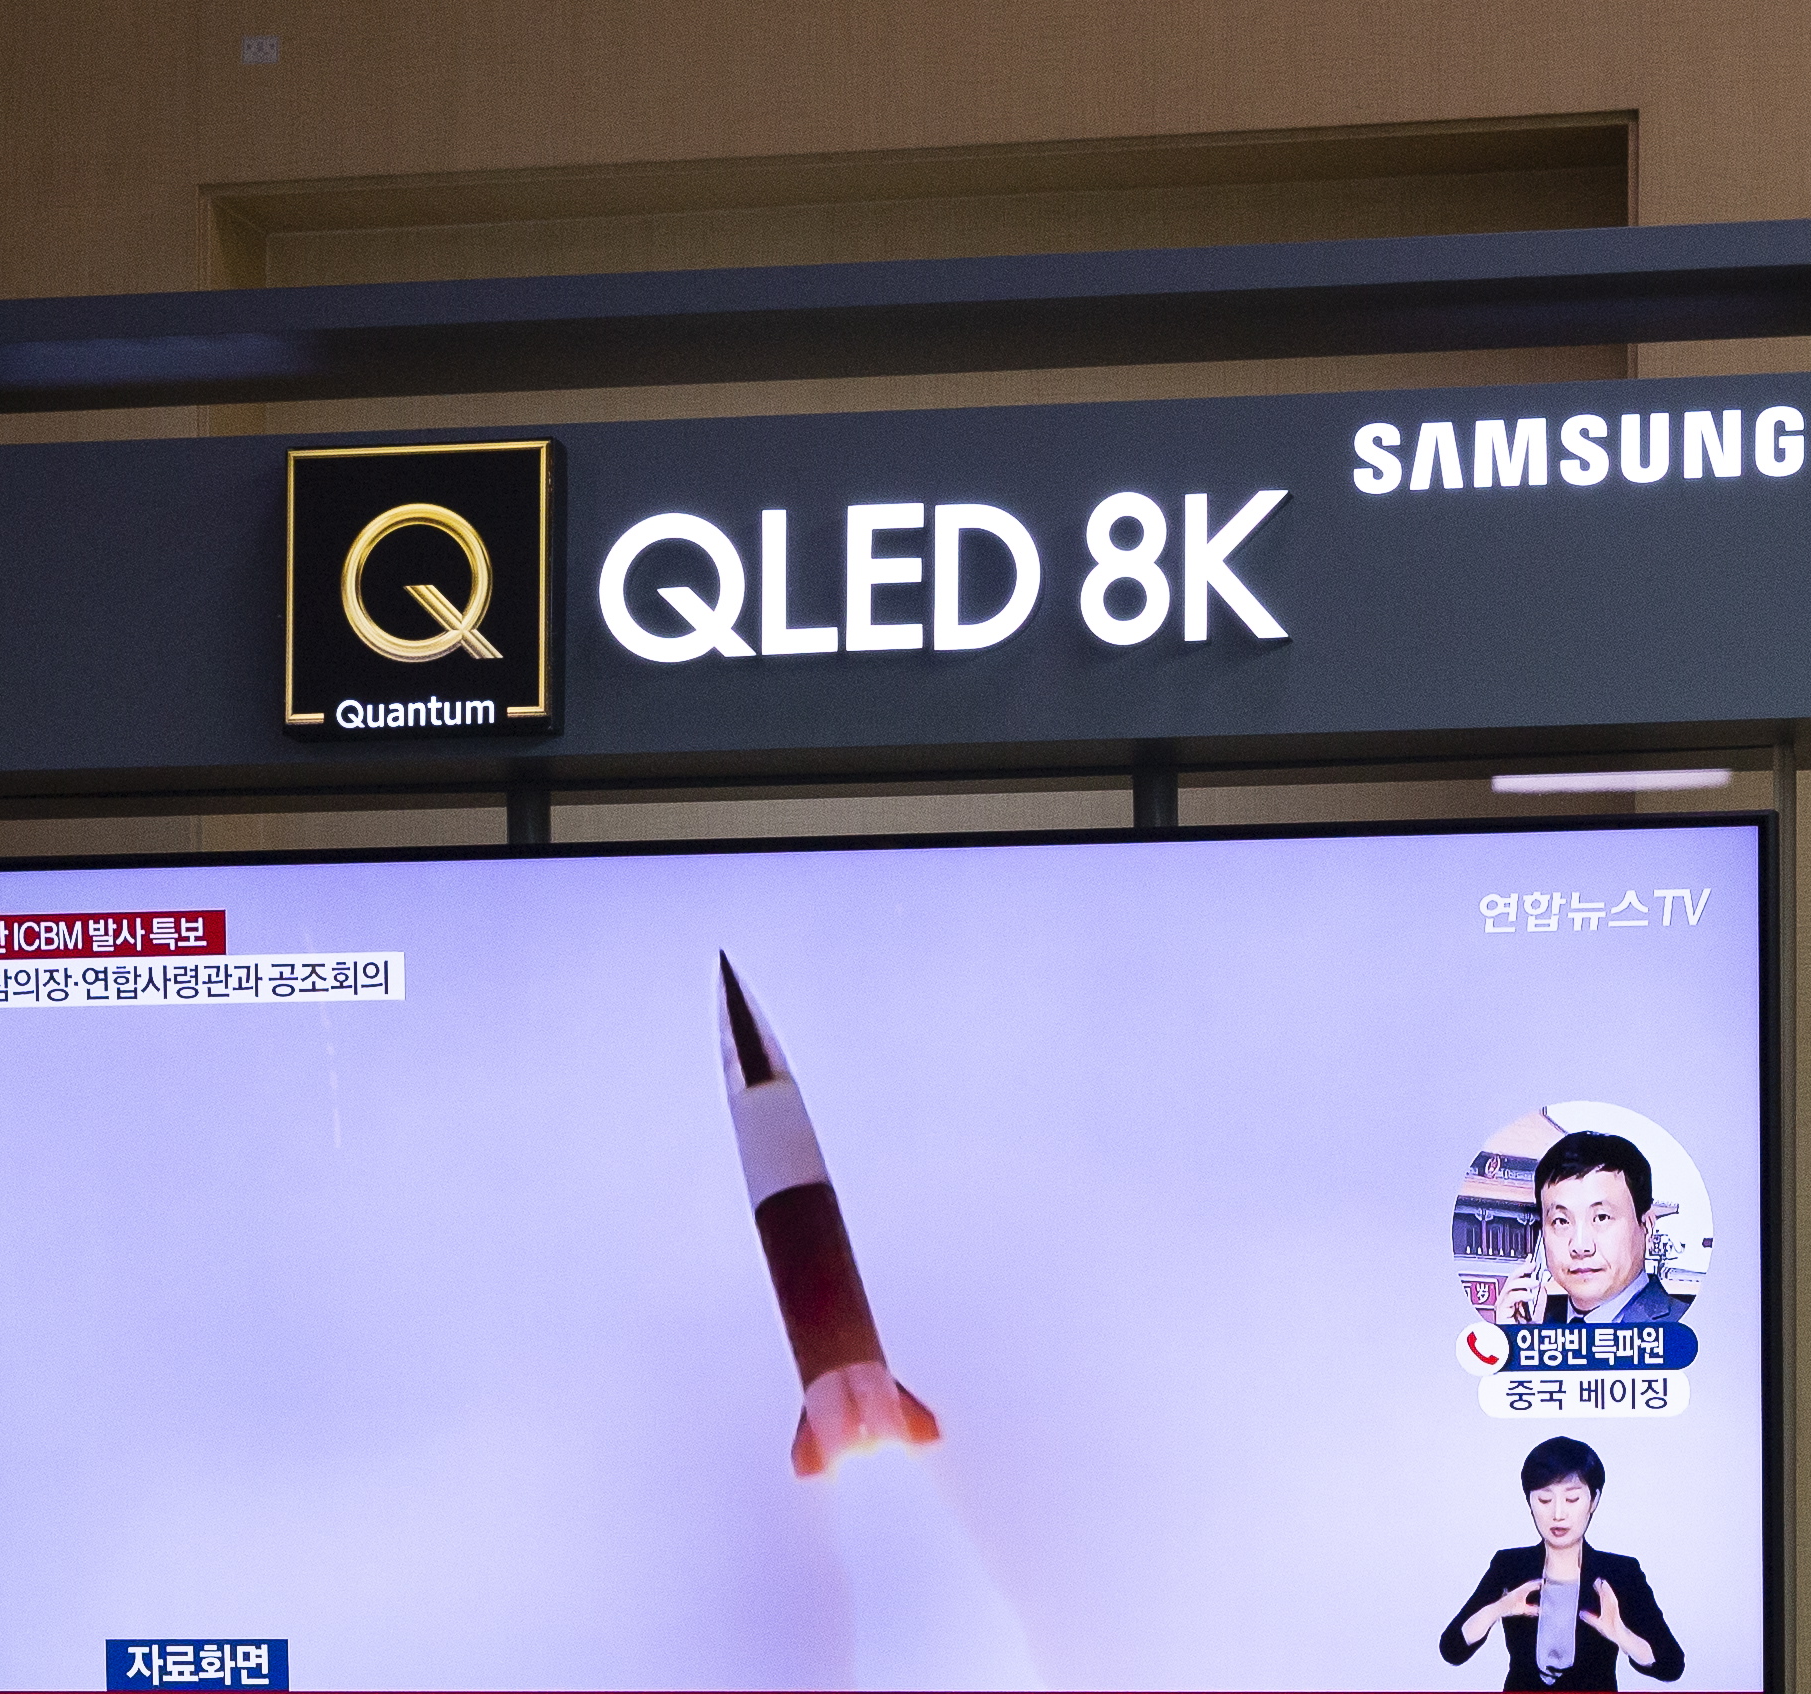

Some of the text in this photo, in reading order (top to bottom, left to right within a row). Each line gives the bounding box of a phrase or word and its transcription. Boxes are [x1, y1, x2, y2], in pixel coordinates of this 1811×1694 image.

[1354, 406, 1806, 496] SAMSUNG
[340, 502, 505, 661] Q
[599, 490, 1290, 664] QLED 8K
[336, 696, 496, 730] Quantum
[1479, 888, 1712, 933] 연합뉴스TV
[14, 920, 84, 951] ICBM
[89, 918, 147, 953] 발사
[150, 918, 208, 952] 특보
[269, 960, 391, 999] 공조회의
[1515, 1327, 1665, 1366] 임광빈 특파원
[1505, 1378, 1670, 1411] 중국 베이징
[126, 1644, 272, 1687] 자료화면
